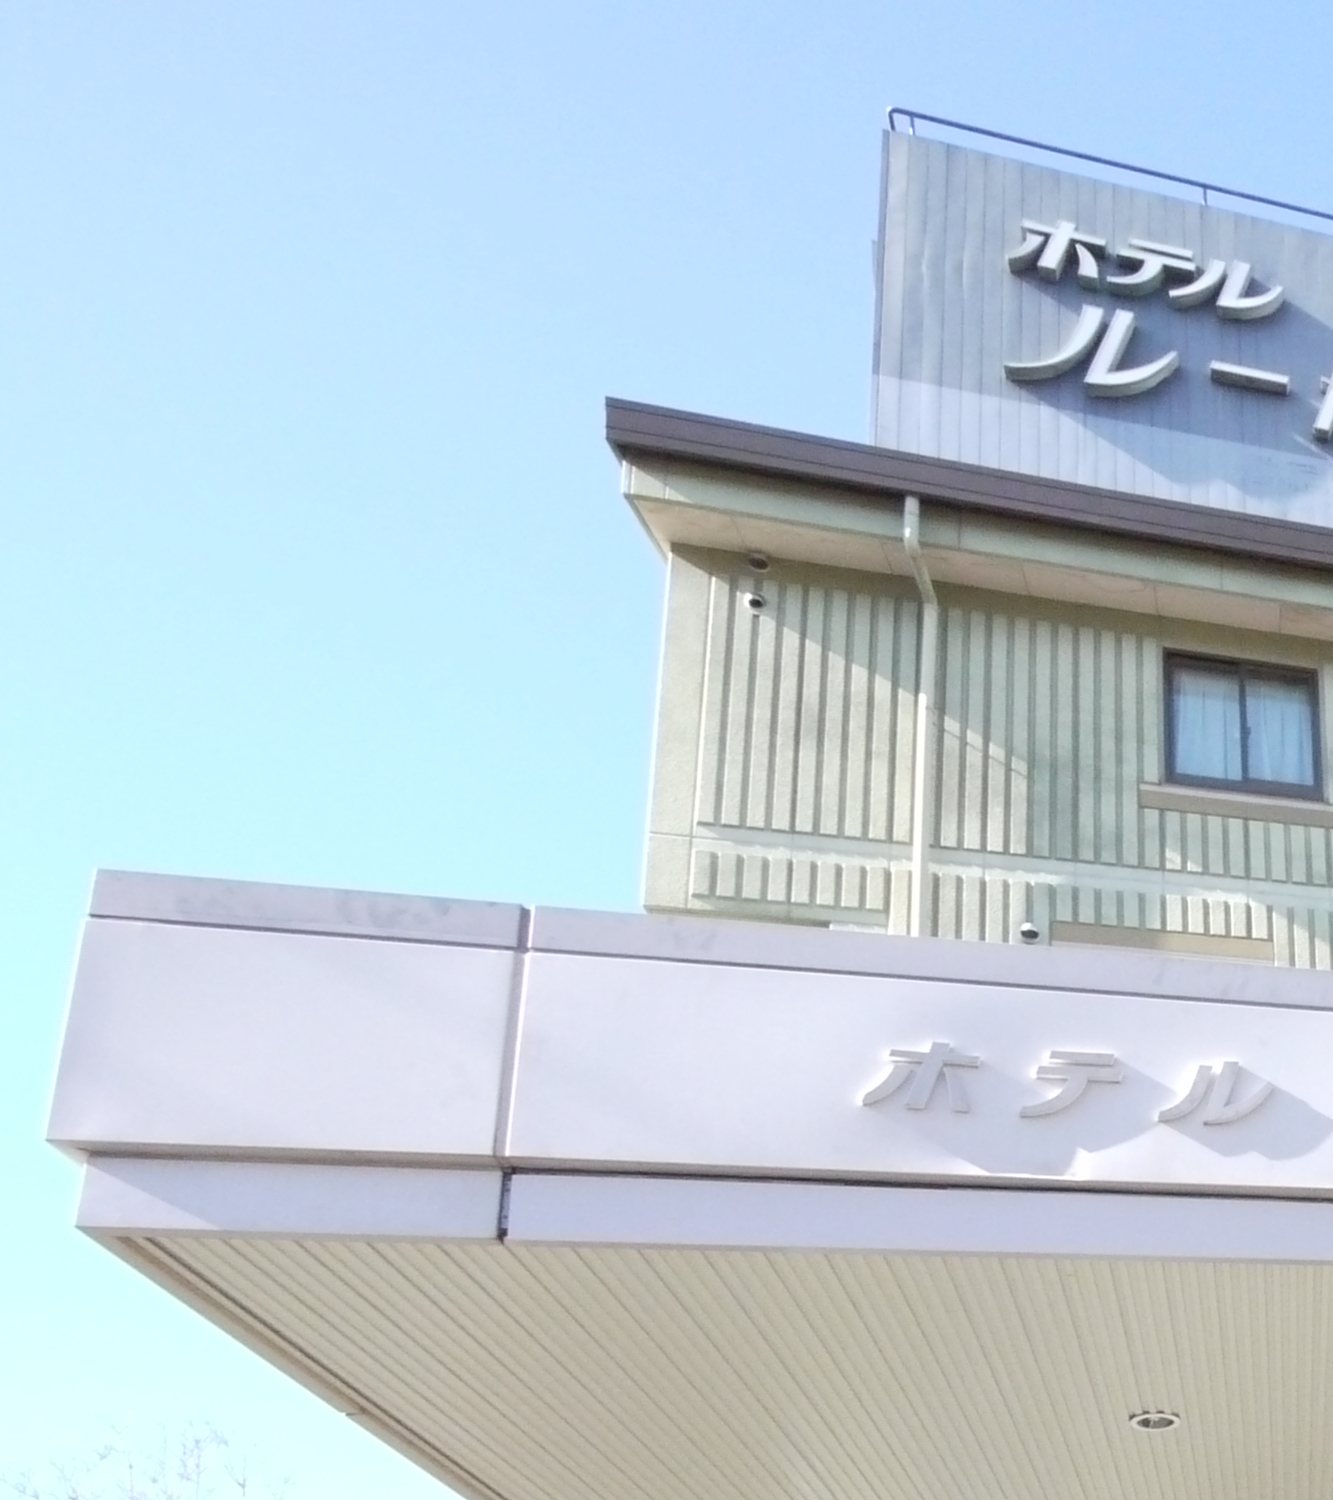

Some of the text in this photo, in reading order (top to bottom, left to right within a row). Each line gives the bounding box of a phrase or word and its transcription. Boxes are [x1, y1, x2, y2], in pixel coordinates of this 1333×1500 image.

[1006, 219, 1285, 321] ホテル
[861, 1040, 1275, 1127] ホテル
